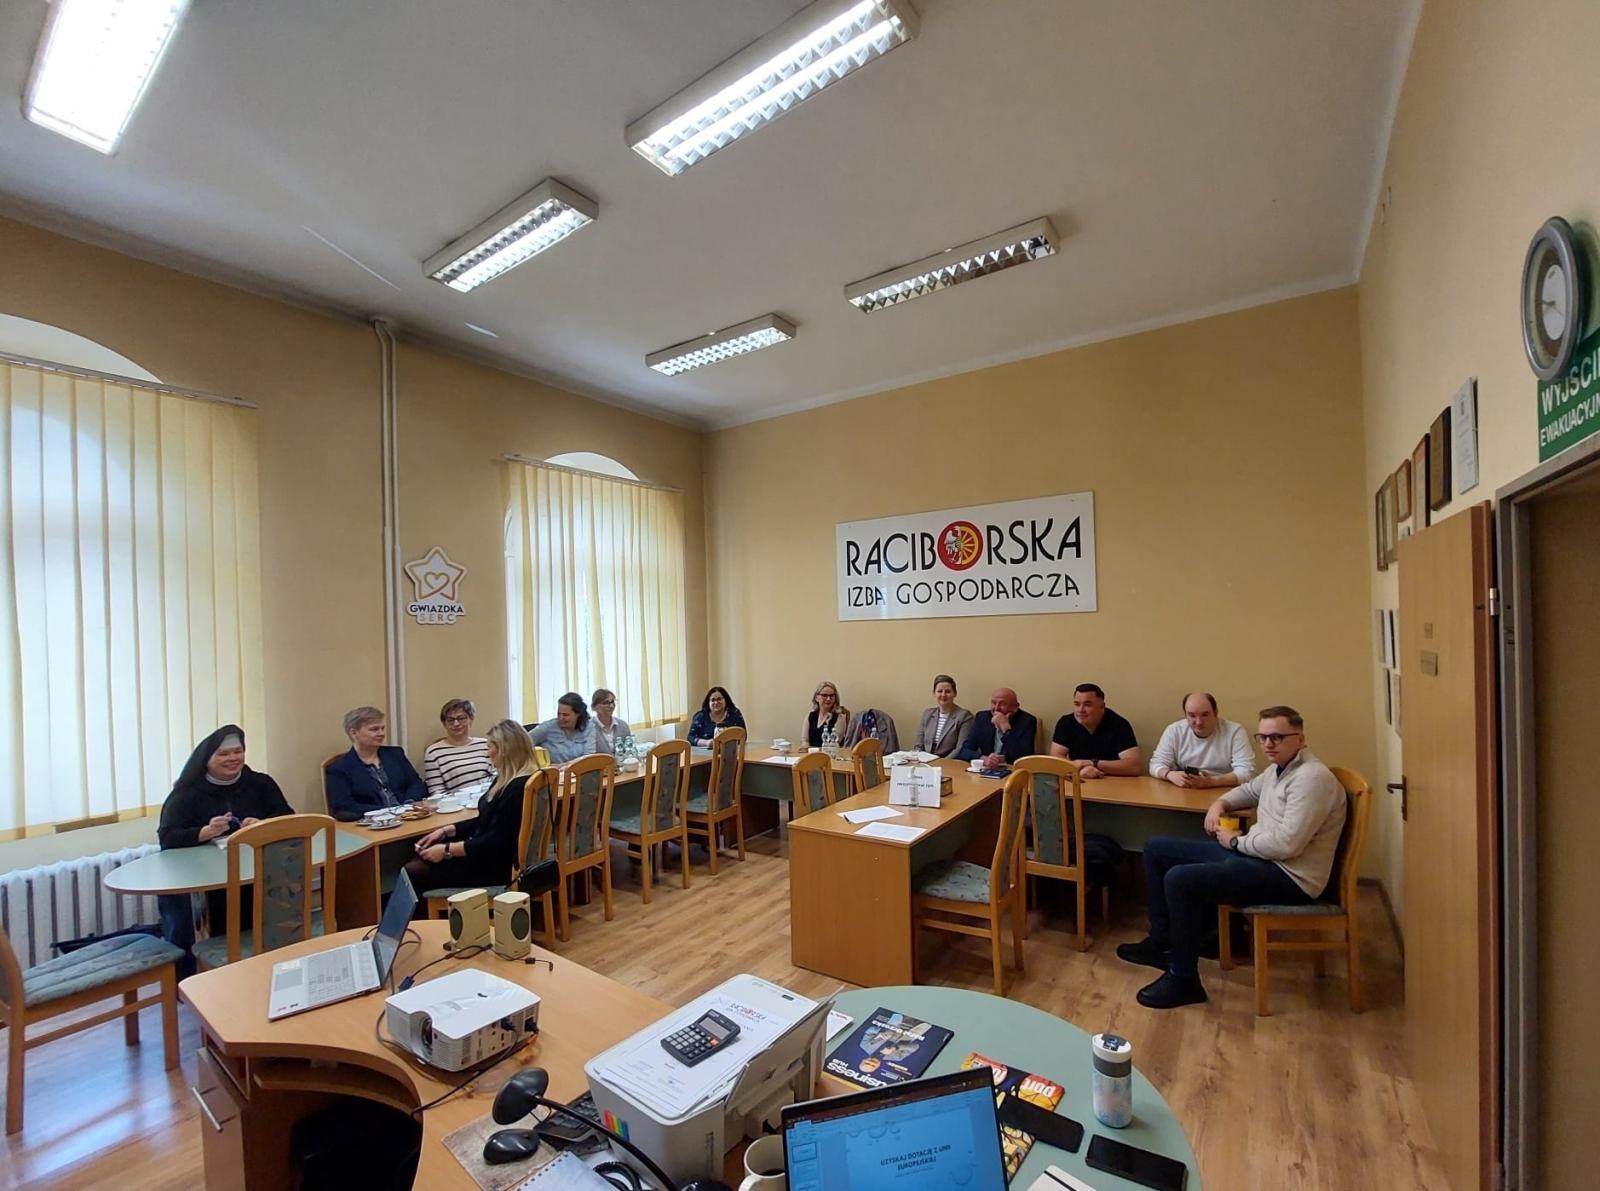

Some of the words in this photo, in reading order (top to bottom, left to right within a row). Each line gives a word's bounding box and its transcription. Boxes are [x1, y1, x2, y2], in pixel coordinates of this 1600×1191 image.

[846, 515, 1082, 576] RACIBORSKA
[848, 586, 886, 607] IZBA
[896, 573, 1080, 605] GOSPODARCZA
[409, 604, 464, 613] GWIAZDKA
[419, 614, 455, 622] SERC
[826, 1061, 889, 1088] usiness
